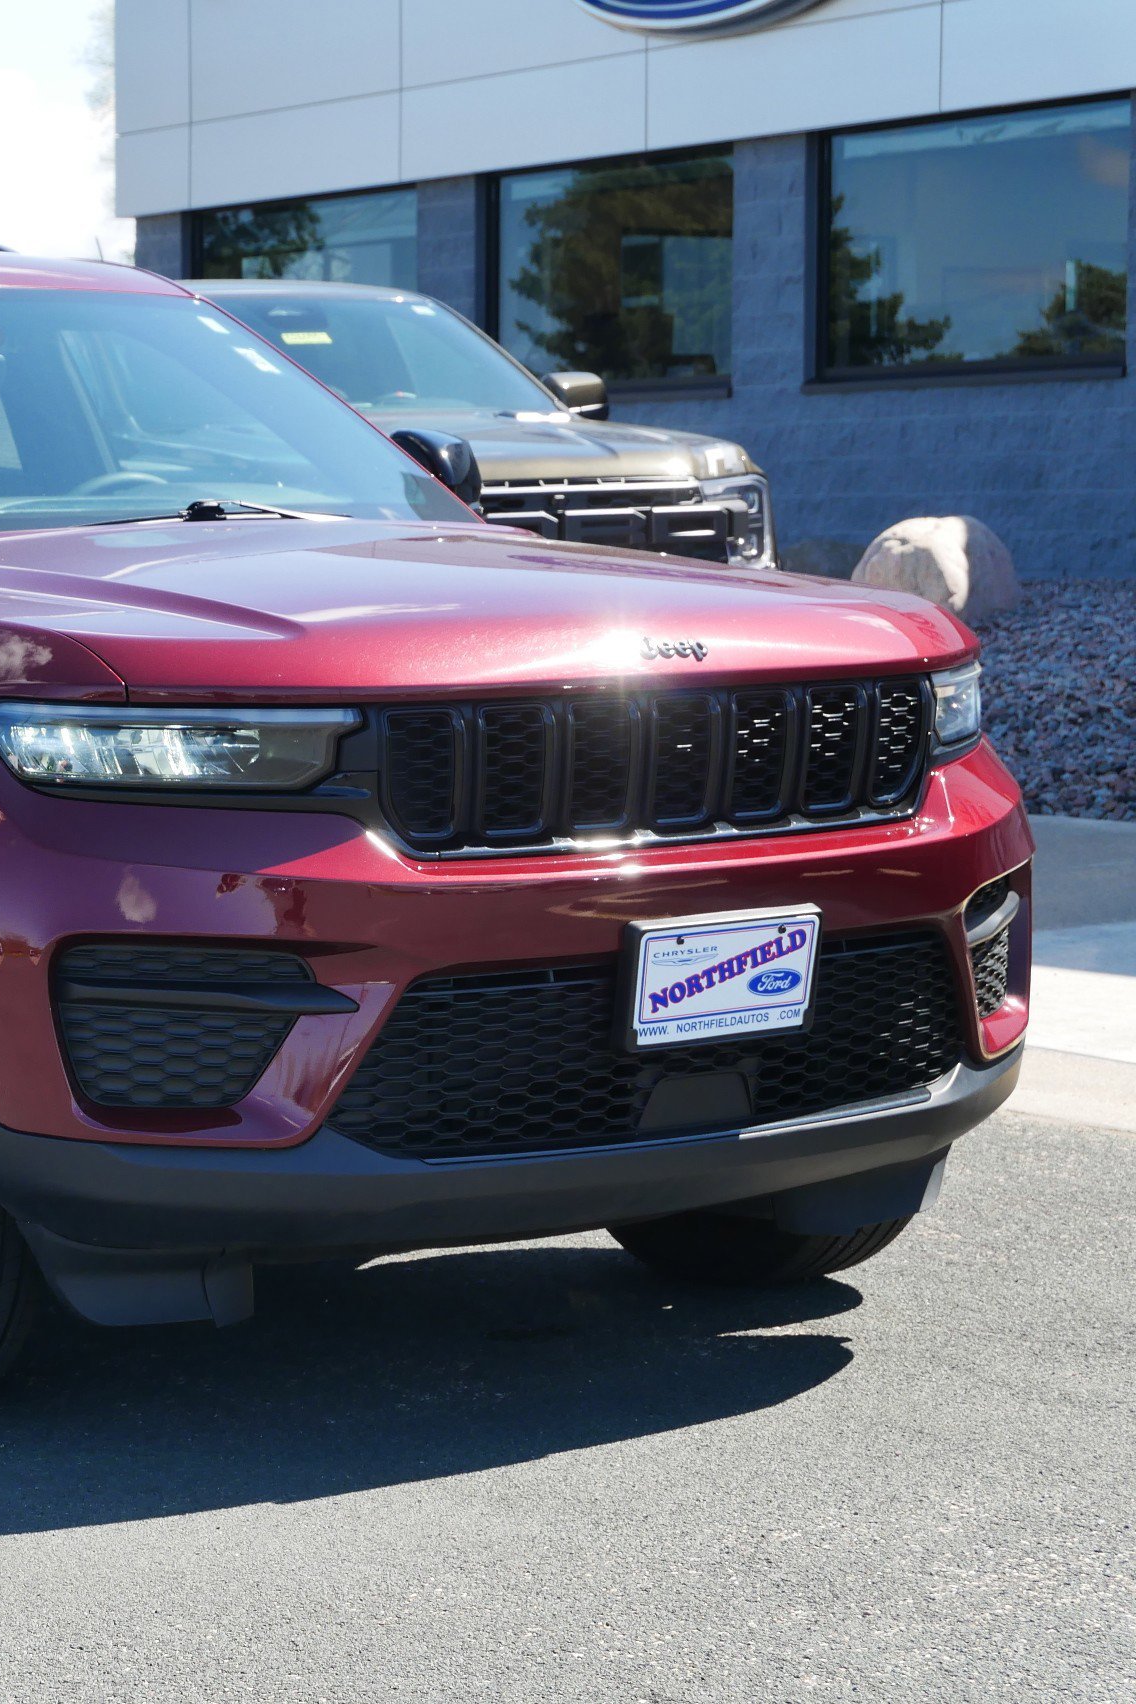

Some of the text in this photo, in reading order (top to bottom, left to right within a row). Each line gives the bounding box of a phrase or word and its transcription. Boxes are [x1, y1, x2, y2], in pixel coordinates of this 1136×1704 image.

[640, 636, 708, 662] Jeep
[653, 945, 719, 959] CHRYSLER
[648, 928, 807, 1014] NORTHFIELD
[757, 972, 791, 991] Ford
[638, 1008, 801, 1038] WWW. NORTHFIELDAUTOS .COM
